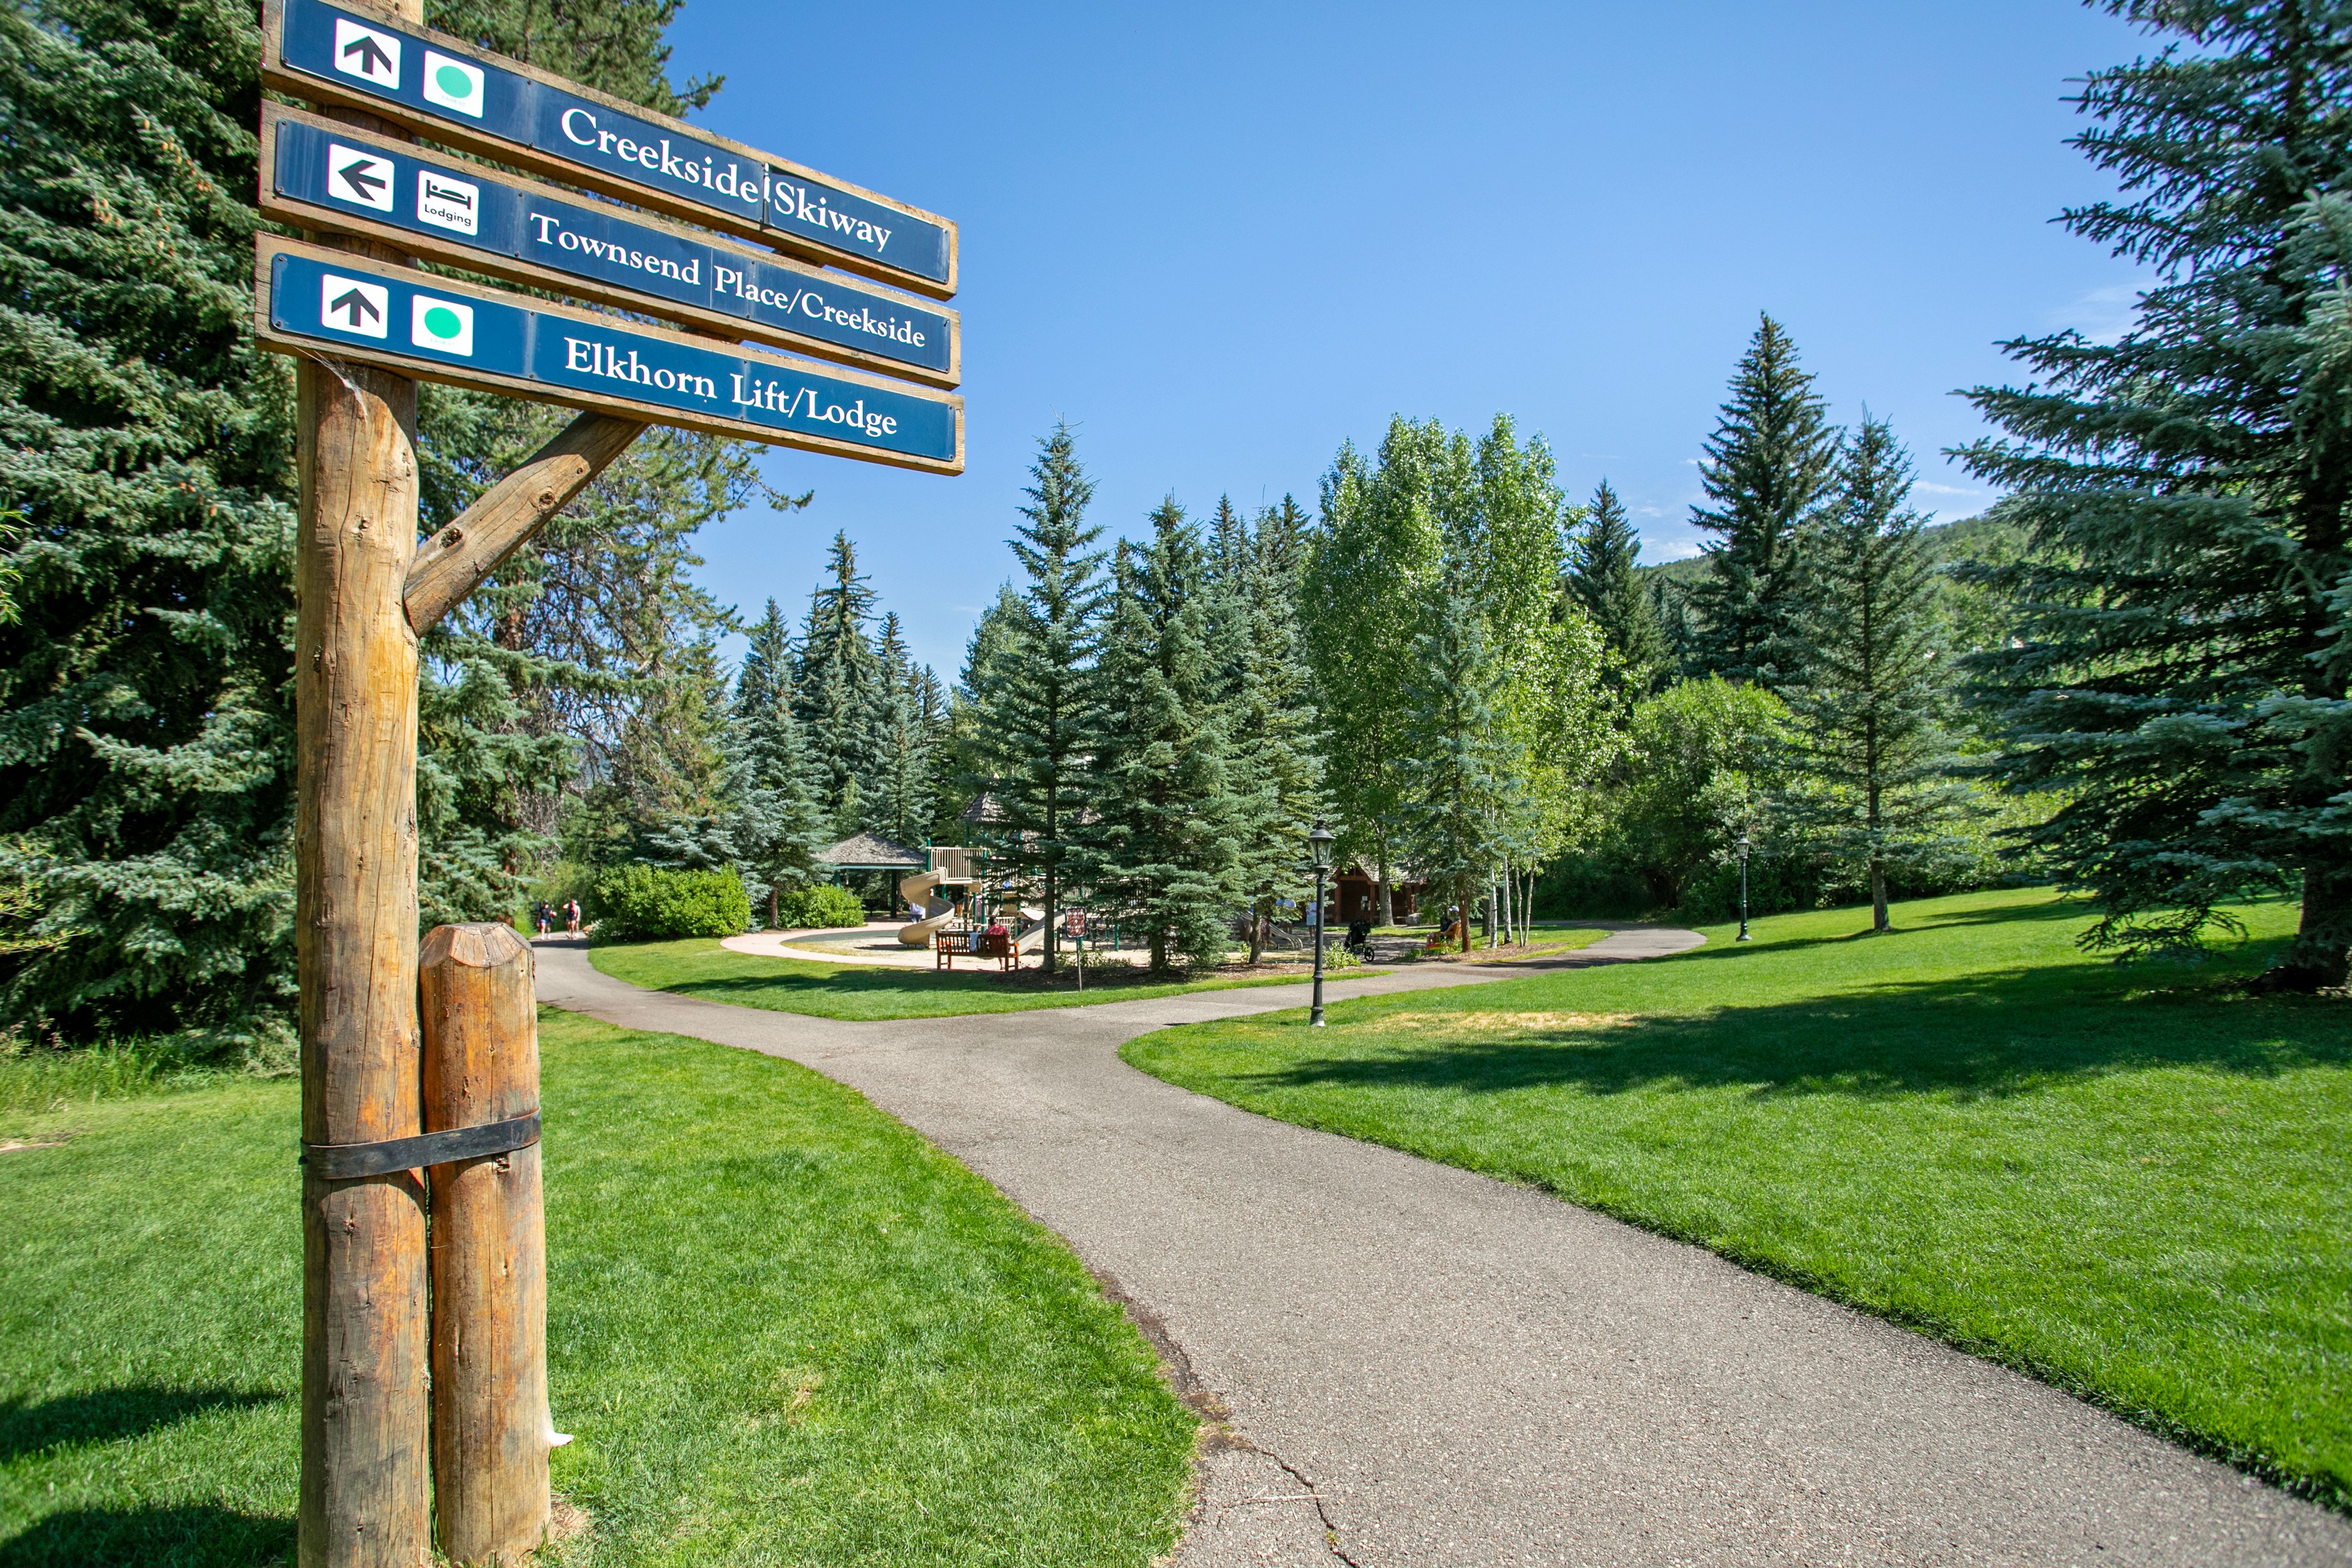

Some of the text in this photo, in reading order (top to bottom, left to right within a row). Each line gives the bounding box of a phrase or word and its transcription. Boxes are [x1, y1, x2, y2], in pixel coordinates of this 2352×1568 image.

[425, 204, 471, 227] Lodging
[561, 108, 892, 253] Creekside Skiway
[530, 212, 925, 347] Townsend Place/Creekside
[563, 336, 897, 437] Elkhorn Lift/Lodge
